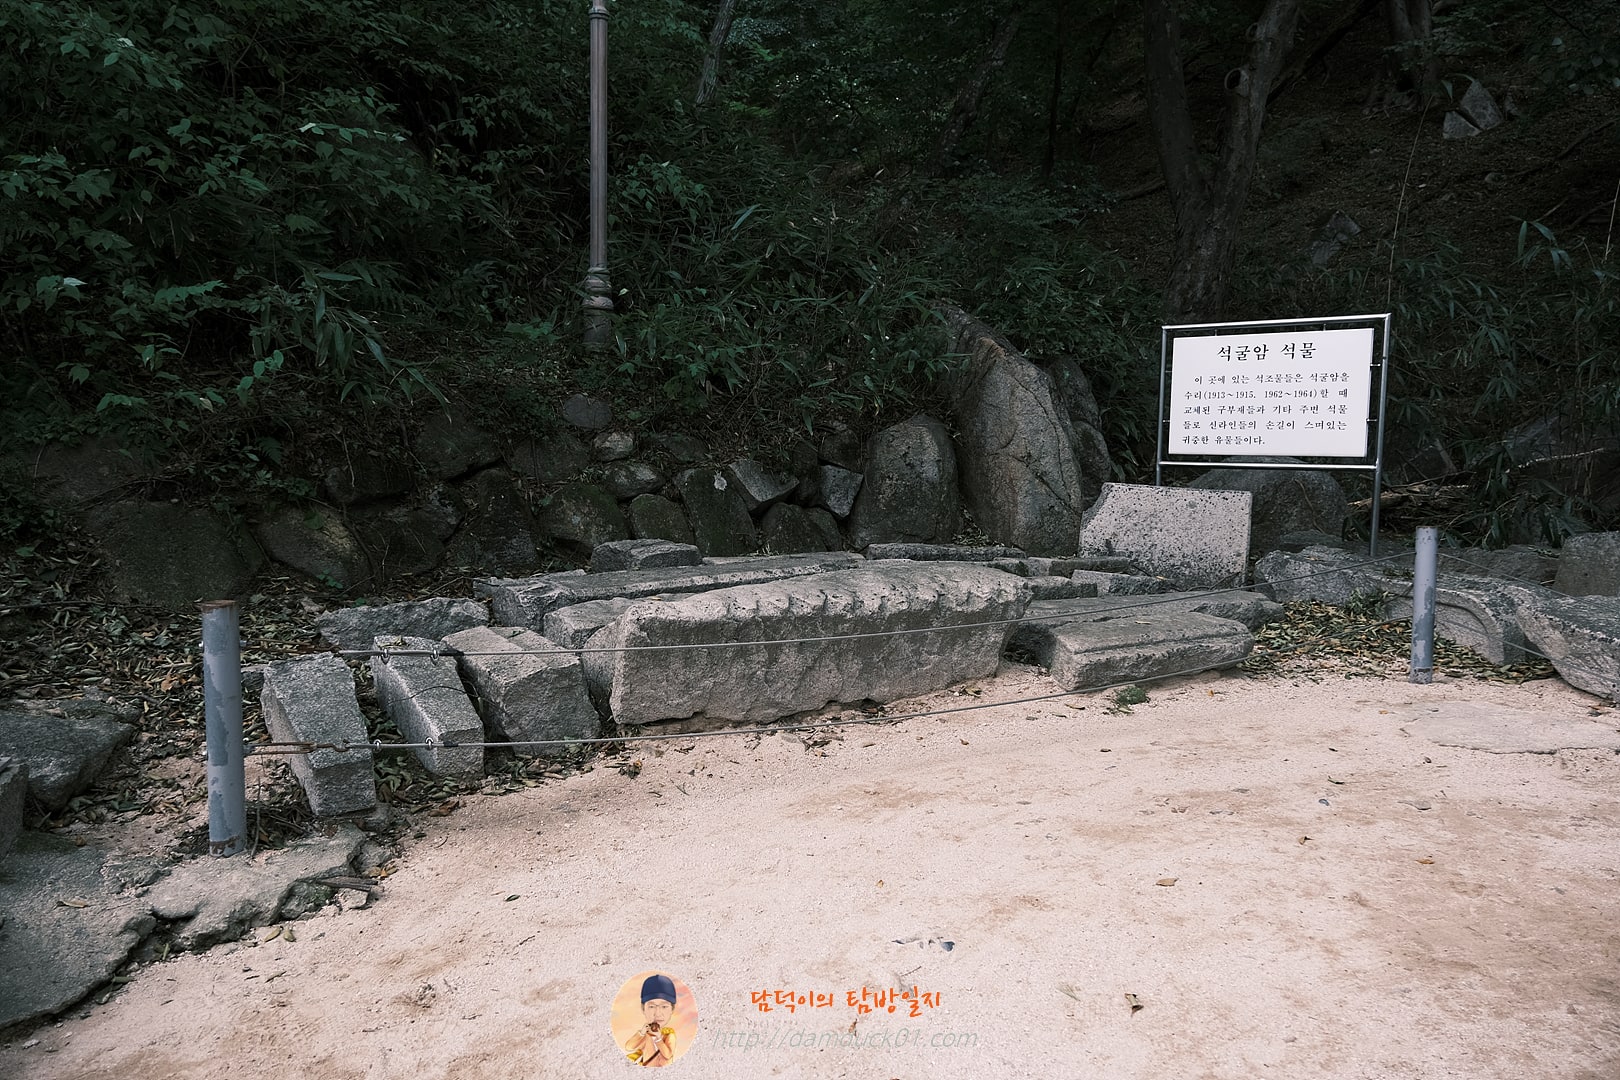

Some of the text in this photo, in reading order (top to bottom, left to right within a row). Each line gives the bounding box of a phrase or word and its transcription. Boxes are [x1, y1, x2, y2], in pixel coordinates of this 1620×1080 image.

[1217, 343, 1316, 361] 석굴암 석물
[1195, 372, 1349, 384] 이 곳에 있는 석조물들은 석굴암을
[1339, 389, 1347, 398] 때
[1184, 404, 1347, 414] 교체된 구부재들과 기타 주변 석물
[1183, 421, 1200, 429] 들로
[1209, 420, 1256, 429] 신라인들의
[1266, 420, 1295, 430] 손길이
[1182, 435, 1265, 445] 귀중한 유물들이다.
